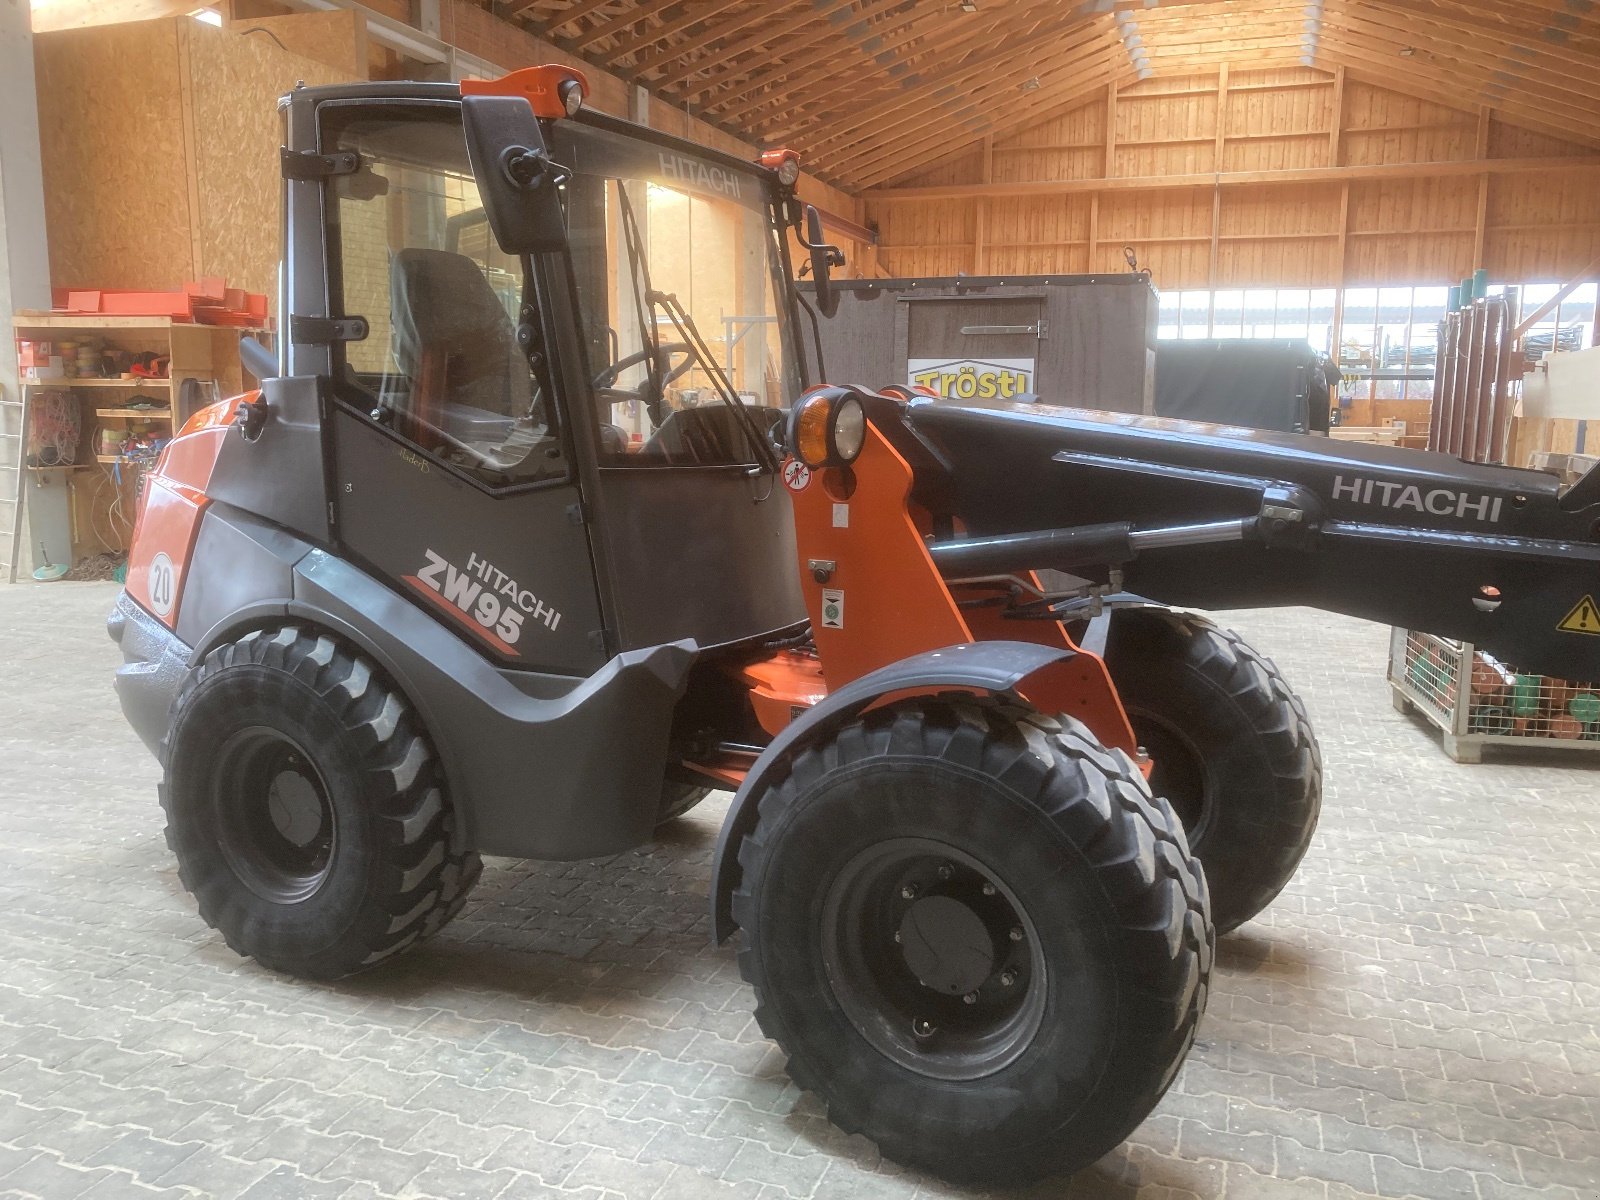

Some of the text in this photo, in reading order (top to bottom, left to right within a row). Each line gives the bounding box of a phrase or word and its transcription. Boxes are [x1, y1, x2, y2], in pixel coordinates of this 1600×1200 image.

[658, 152, 741, 199] HITACHI
[1331, 475, 1503, 523] HITACHI
[153, 564, 170, 606] 20
[416, 548, 525, 644] ZW95
[466, 552, 562, 632] HITACHI
